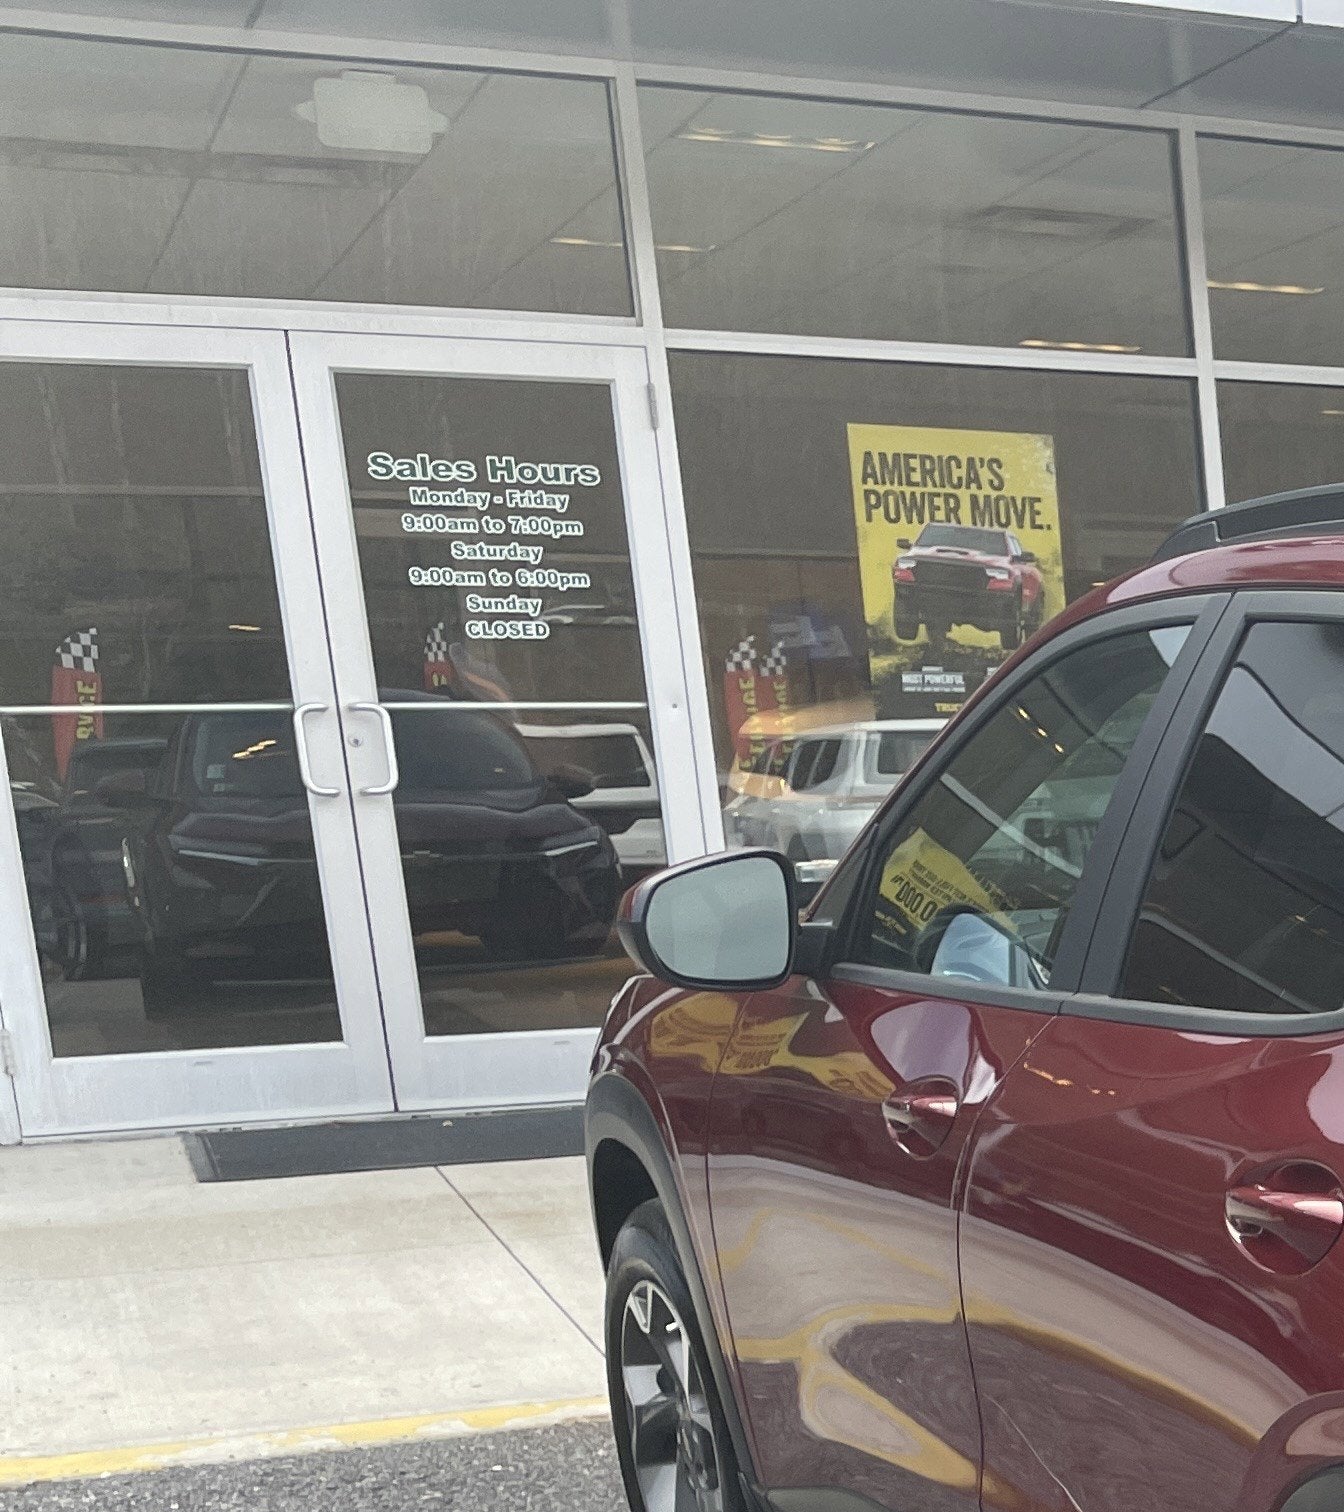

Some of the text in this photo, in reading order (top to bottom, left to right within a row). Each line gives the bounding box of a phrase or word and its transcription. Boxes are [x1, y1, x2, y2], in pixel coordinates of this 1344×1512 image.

[368, 452, 601, 486] Sales Hours
[862, 450, 1005, 491] AMERICA'S
[409, 487, 490, 510] Monday
[505, 489, 569, 513] Friday
[864, 489, 1052, 530] POWER MOVE.
[401, 514, 584, 539] 9:00am to 7:00pm
[451, 541, 543, 564] Saturday
[408, 567, 591, 591] 9:00am to 6:00pm
[466, 594, 542, 616] Sunday
[465, 620, 550, 639] CLOSED
